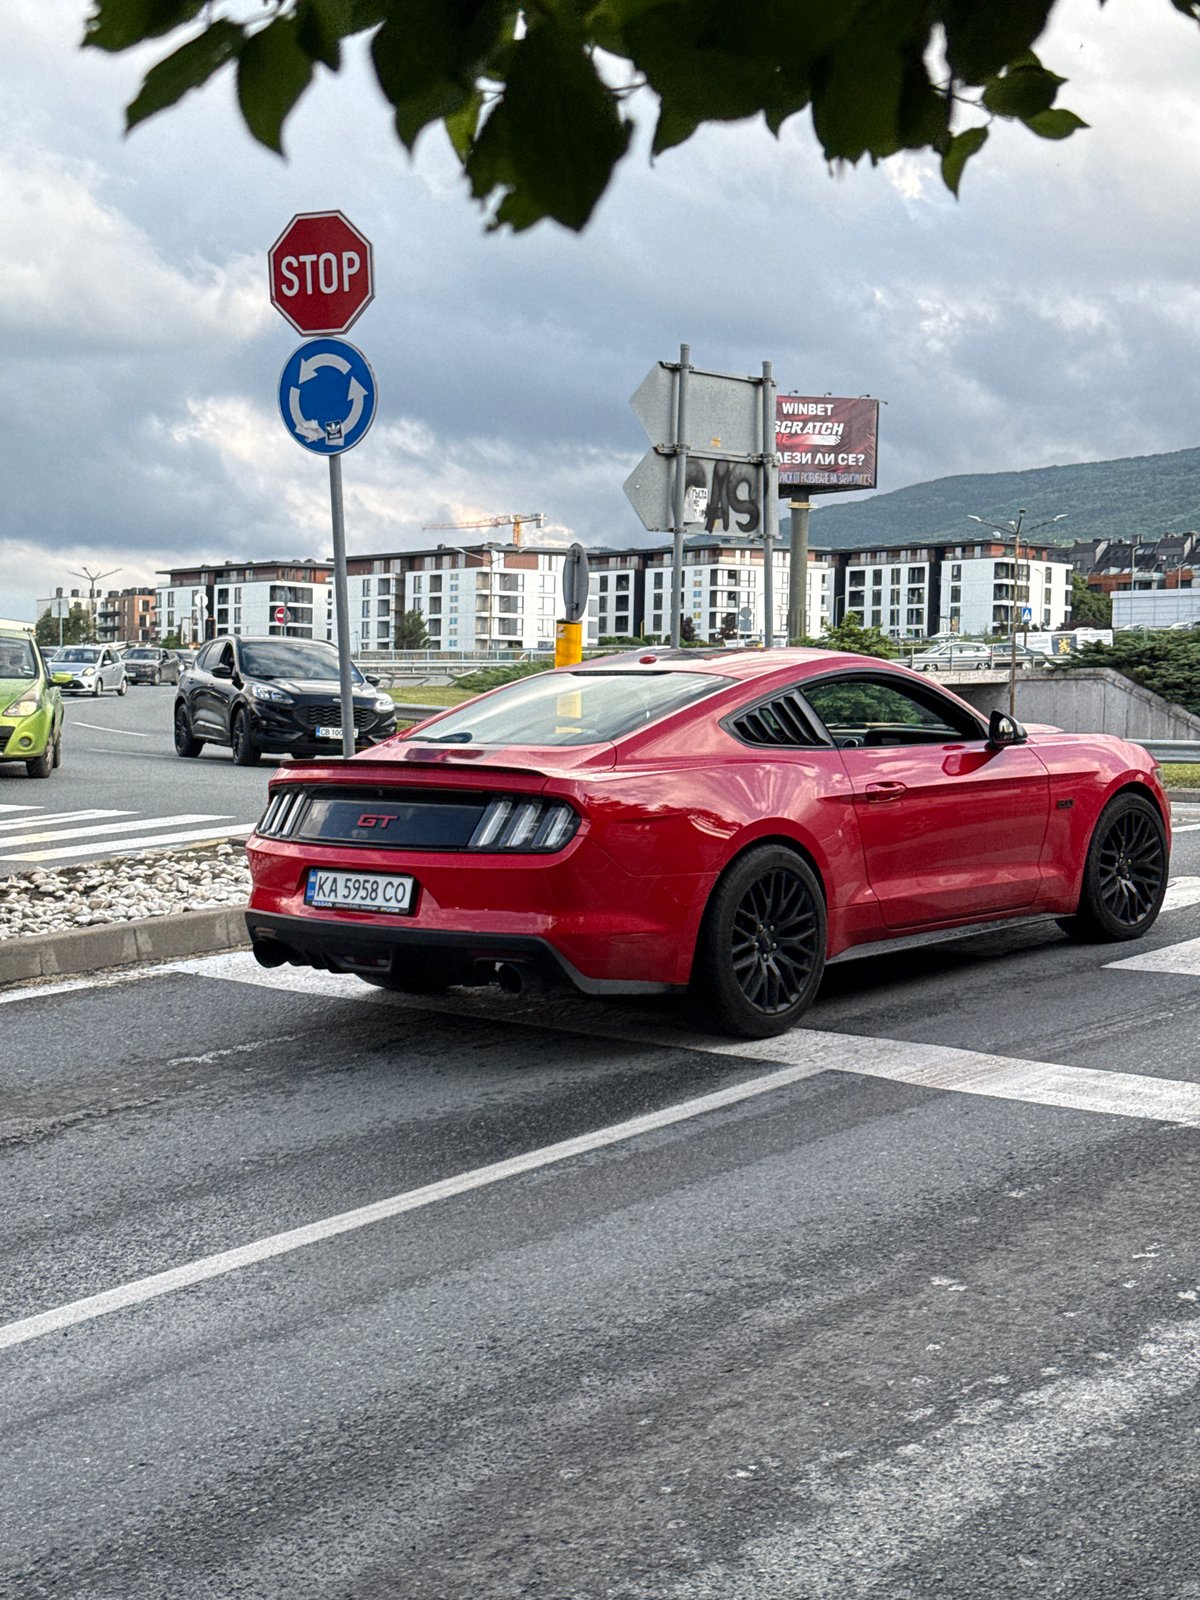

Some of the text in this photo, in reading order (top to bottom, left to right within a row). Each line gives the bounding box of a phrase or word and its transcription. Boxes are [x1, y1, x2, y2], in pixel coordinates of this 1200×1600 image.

[281, 251, 361, 297] STOP
[782, 402, 834, 416] WINBET
[814, 453, 835, 466] ЛИ
[838, 453, 865, 466] СЕ?
[357, 814, 399, 828] GT
[317, 875, 406, 903] KA 5958 CO
